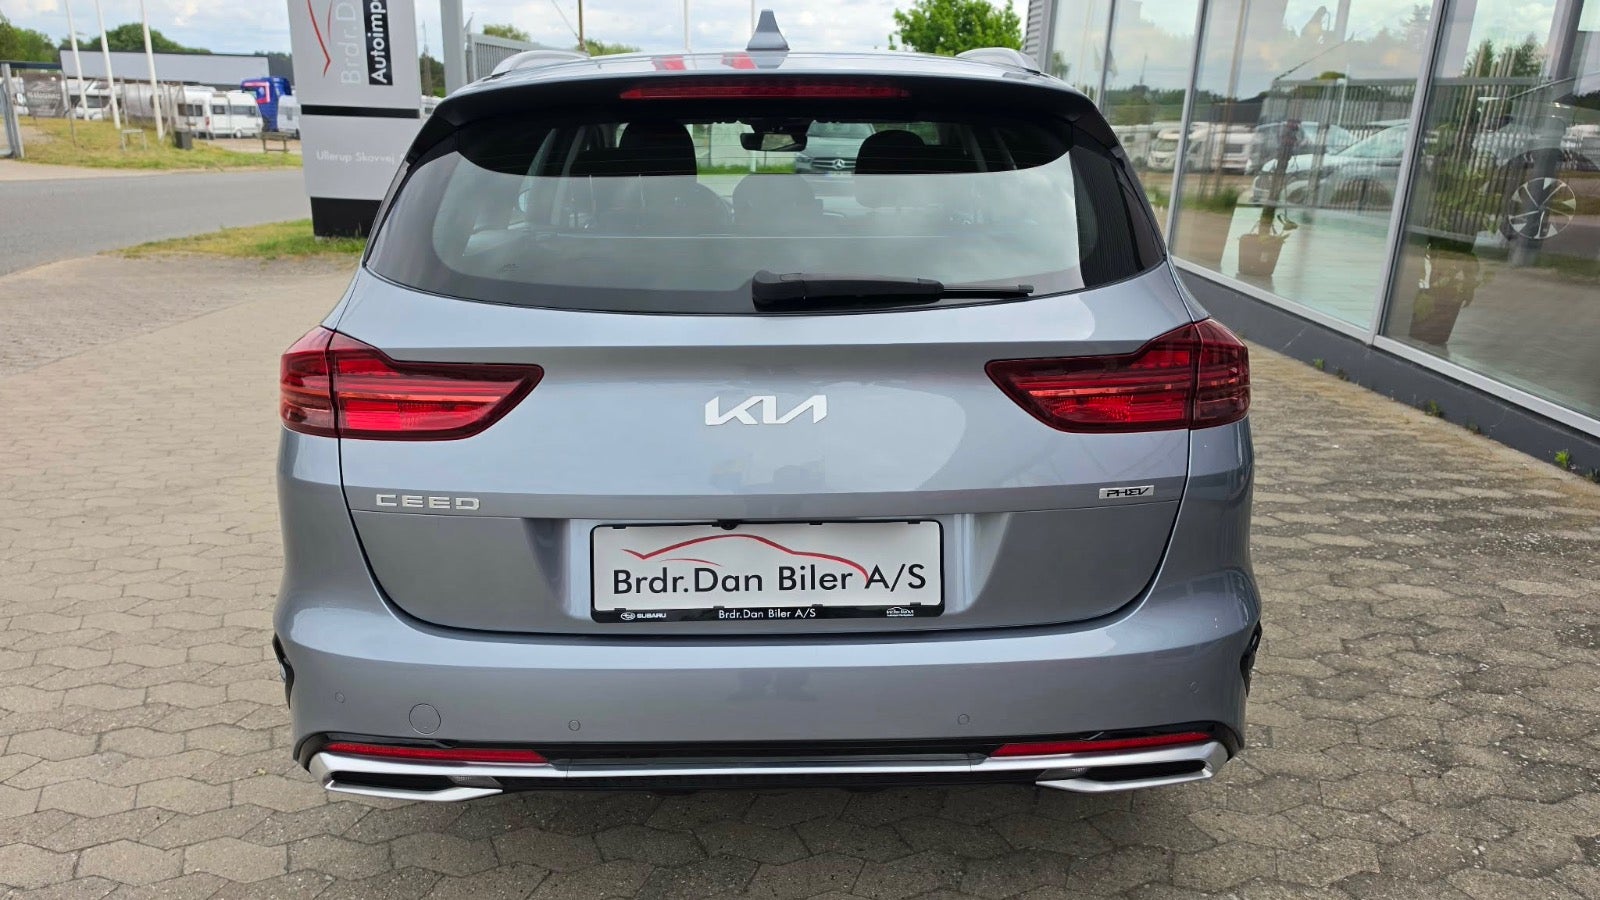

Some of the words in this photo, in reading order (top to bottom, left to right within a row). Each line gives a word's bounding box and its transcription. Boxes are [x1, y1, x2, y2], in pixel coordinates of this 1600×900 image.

[367, 0, 388, 84] Autoimp
[705, 395, 827, 425] KIA
[376, 494, 480, 510] CEED
[1106, 487, 1149, 497] PHEV
[613, 567, 763, 595] Brdr.Dan
[778, 564, 854, 592] Biler
[864, 562, 927, 592] A/S
[718, 609, 764, 619] Brdr.Dan
[768, 608, 791, 618] Biler
[794, 608, 817, 619] A/S
